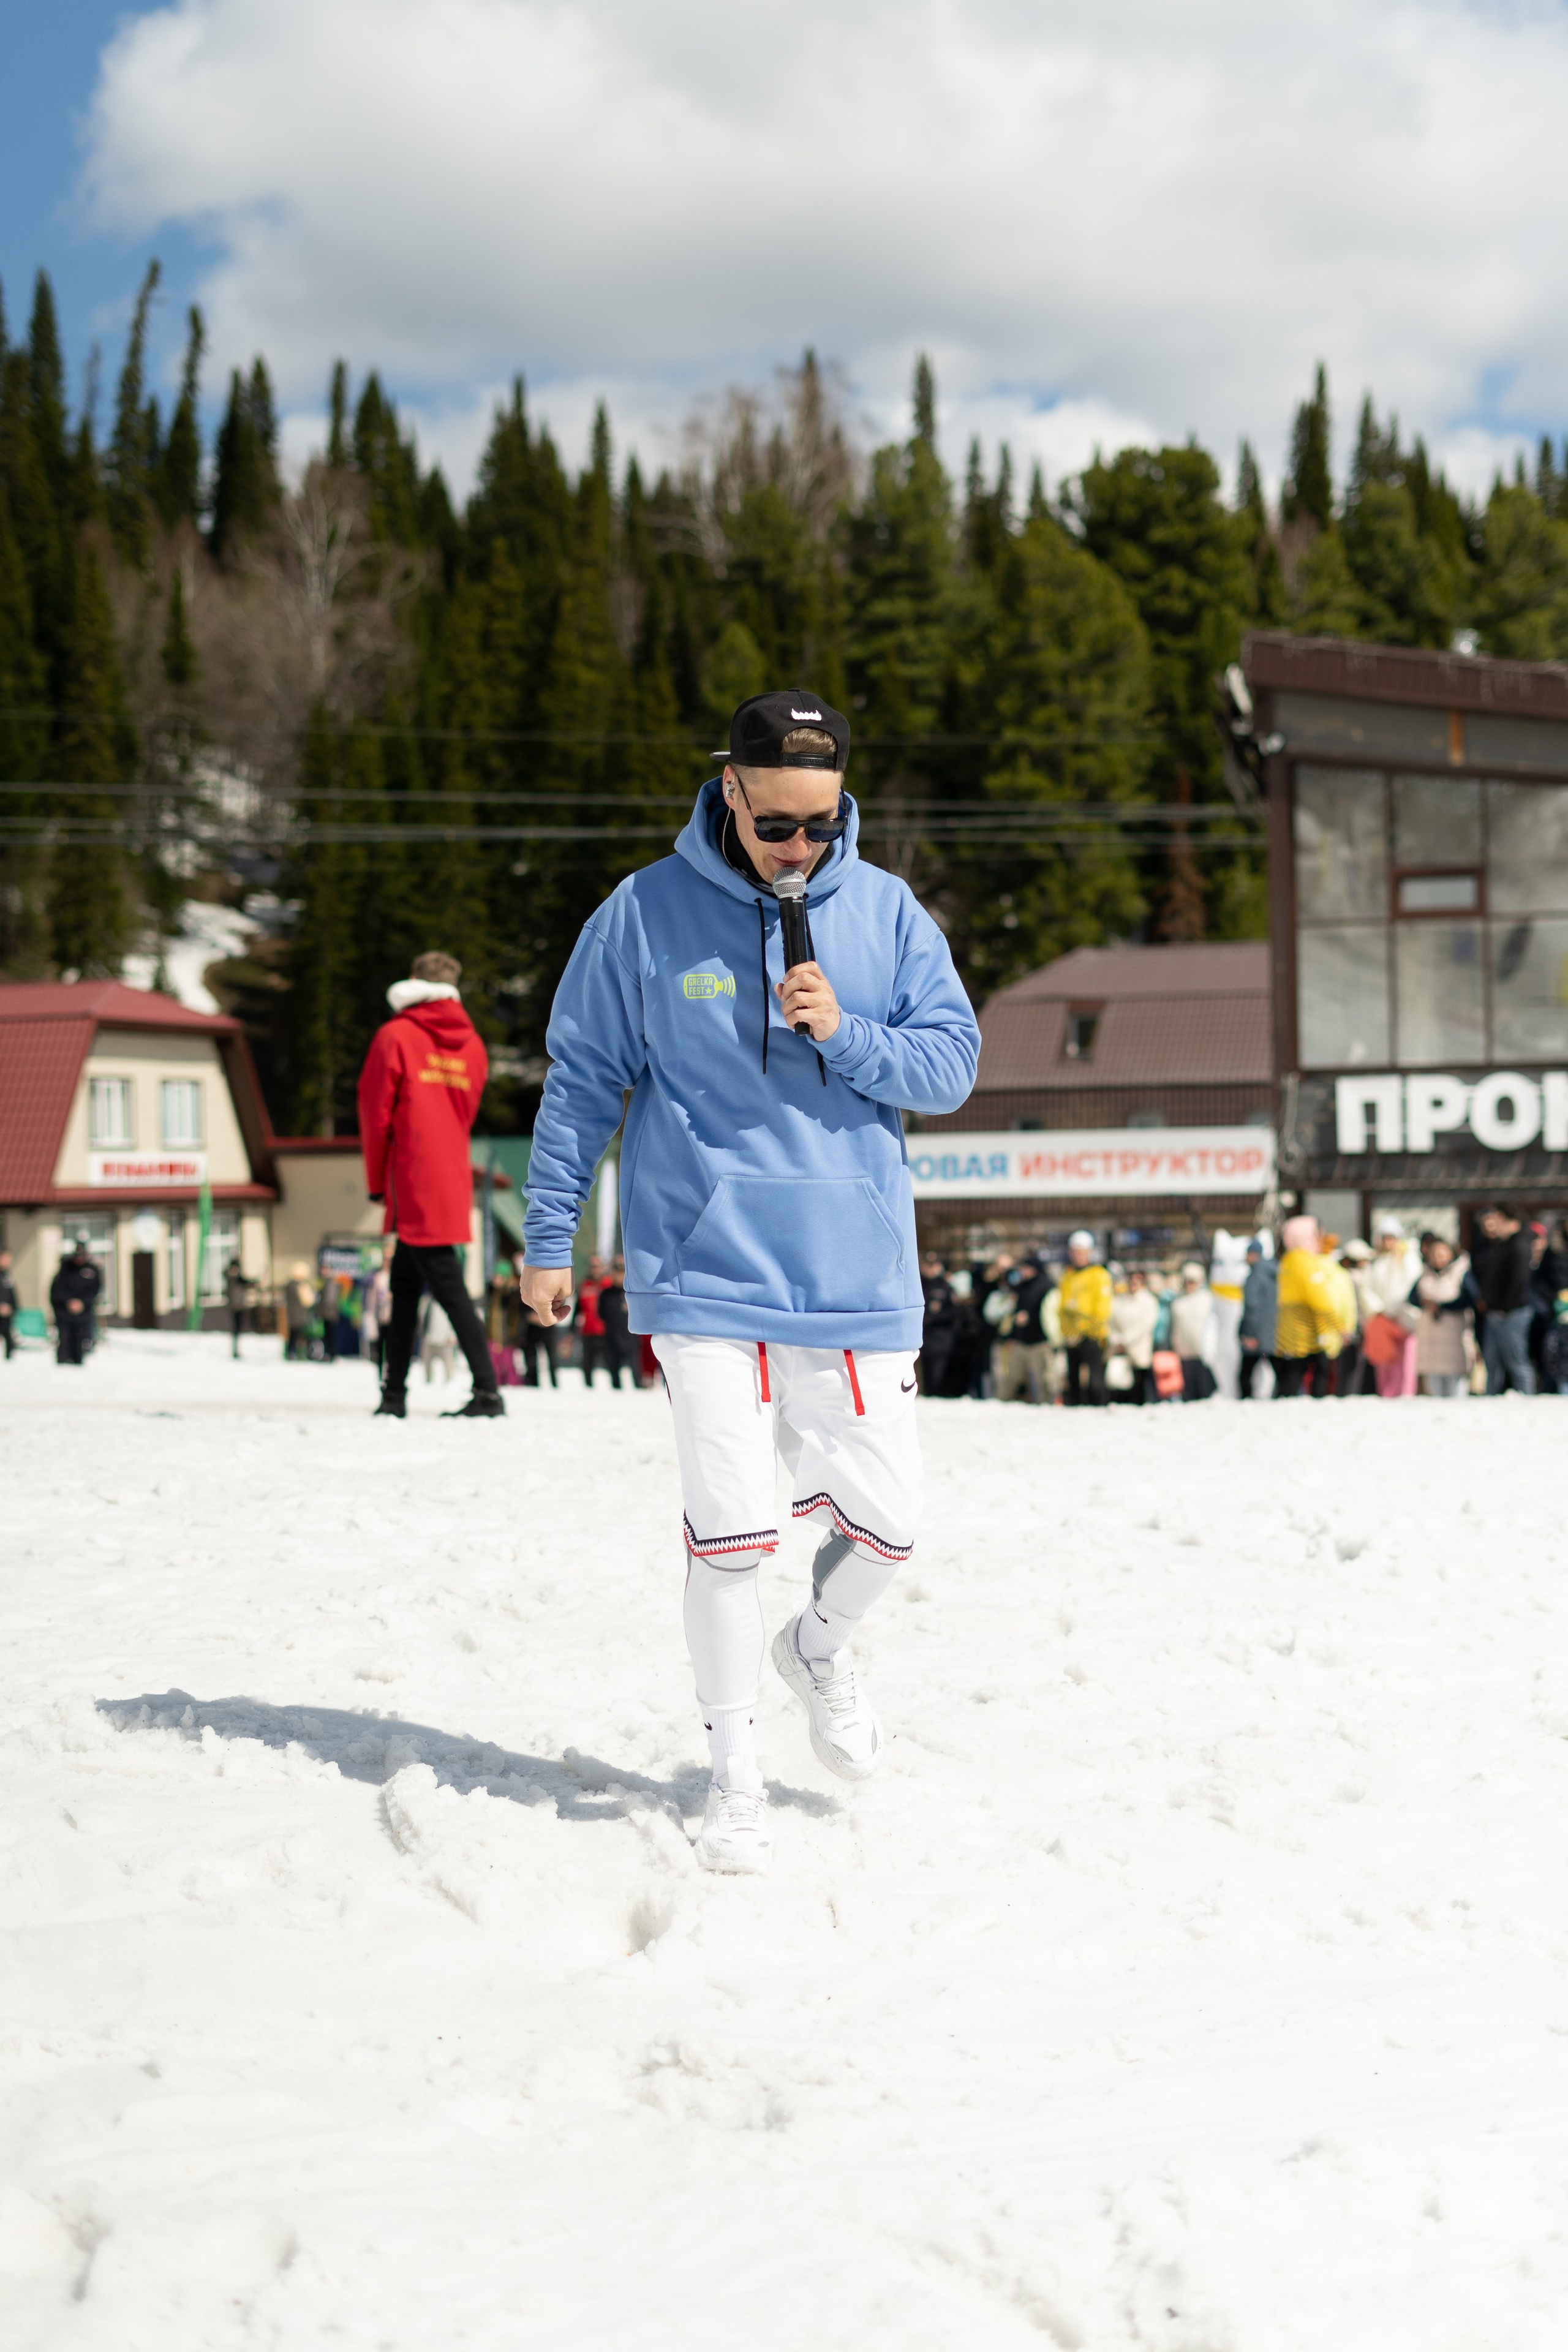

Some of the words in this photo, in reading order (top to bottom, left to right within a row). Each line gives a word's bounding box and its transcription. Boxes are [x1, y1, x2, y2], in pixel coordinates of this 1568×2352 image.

[688, 977, 713, 986] GRELKA
[688, 987, 704, 995] FEST
[910, 1152, 1009, 1182] ОВАЯ
[1020, 1148, 1266, 1180] ИНСТРУКТОР
